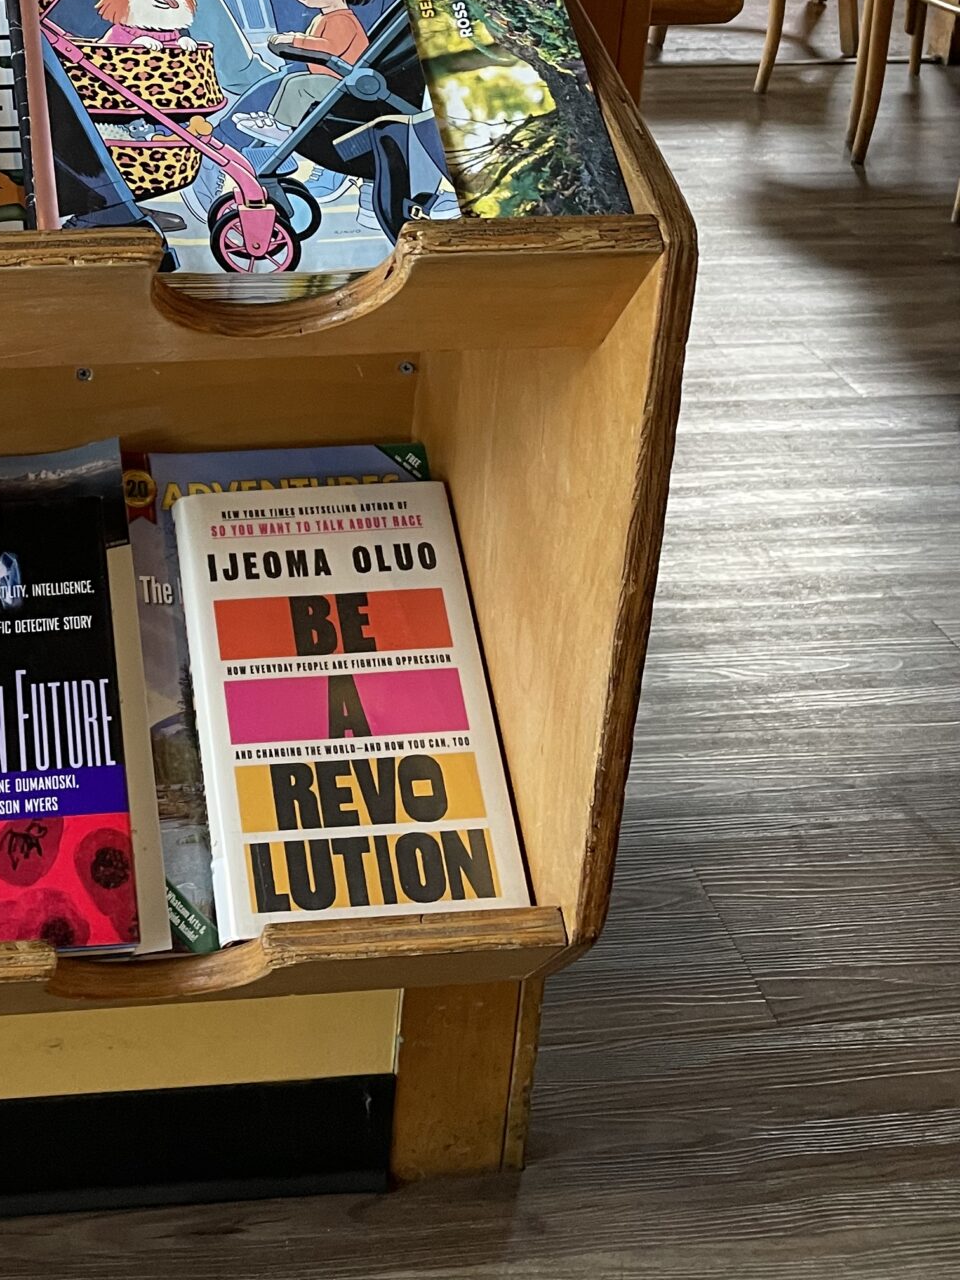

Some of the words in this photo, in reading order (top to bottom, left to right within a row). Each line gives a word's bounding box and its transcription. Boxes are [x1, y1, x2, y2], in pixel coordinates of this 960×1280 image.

[207, 548, 332, 582] IJEOMA
[352, 541, 437, 574] OLUO
[14, 618, 61, 633] DETECTIVE
[63, 615, 92, 631] STORY
[289, 591, 377, 658] BE
[227, 666, 247, 676] HOW
[250, 663, 294, 675] EVERYDAY
[296, 661, 329, 672] PEOPLE
[332, 659, 349, 670] ARE
[351, 657, 393, 669] FIGHTING
[396, 653, 452, 667] OPPRESSION
[16, 669, 117, 773] FUTURE
[328, 674, 373, 739] A
[25, 797, 59, 814] MYERS
[270, 755, 448, 831] REVO
[250, 828, 496, 914] LUTION
